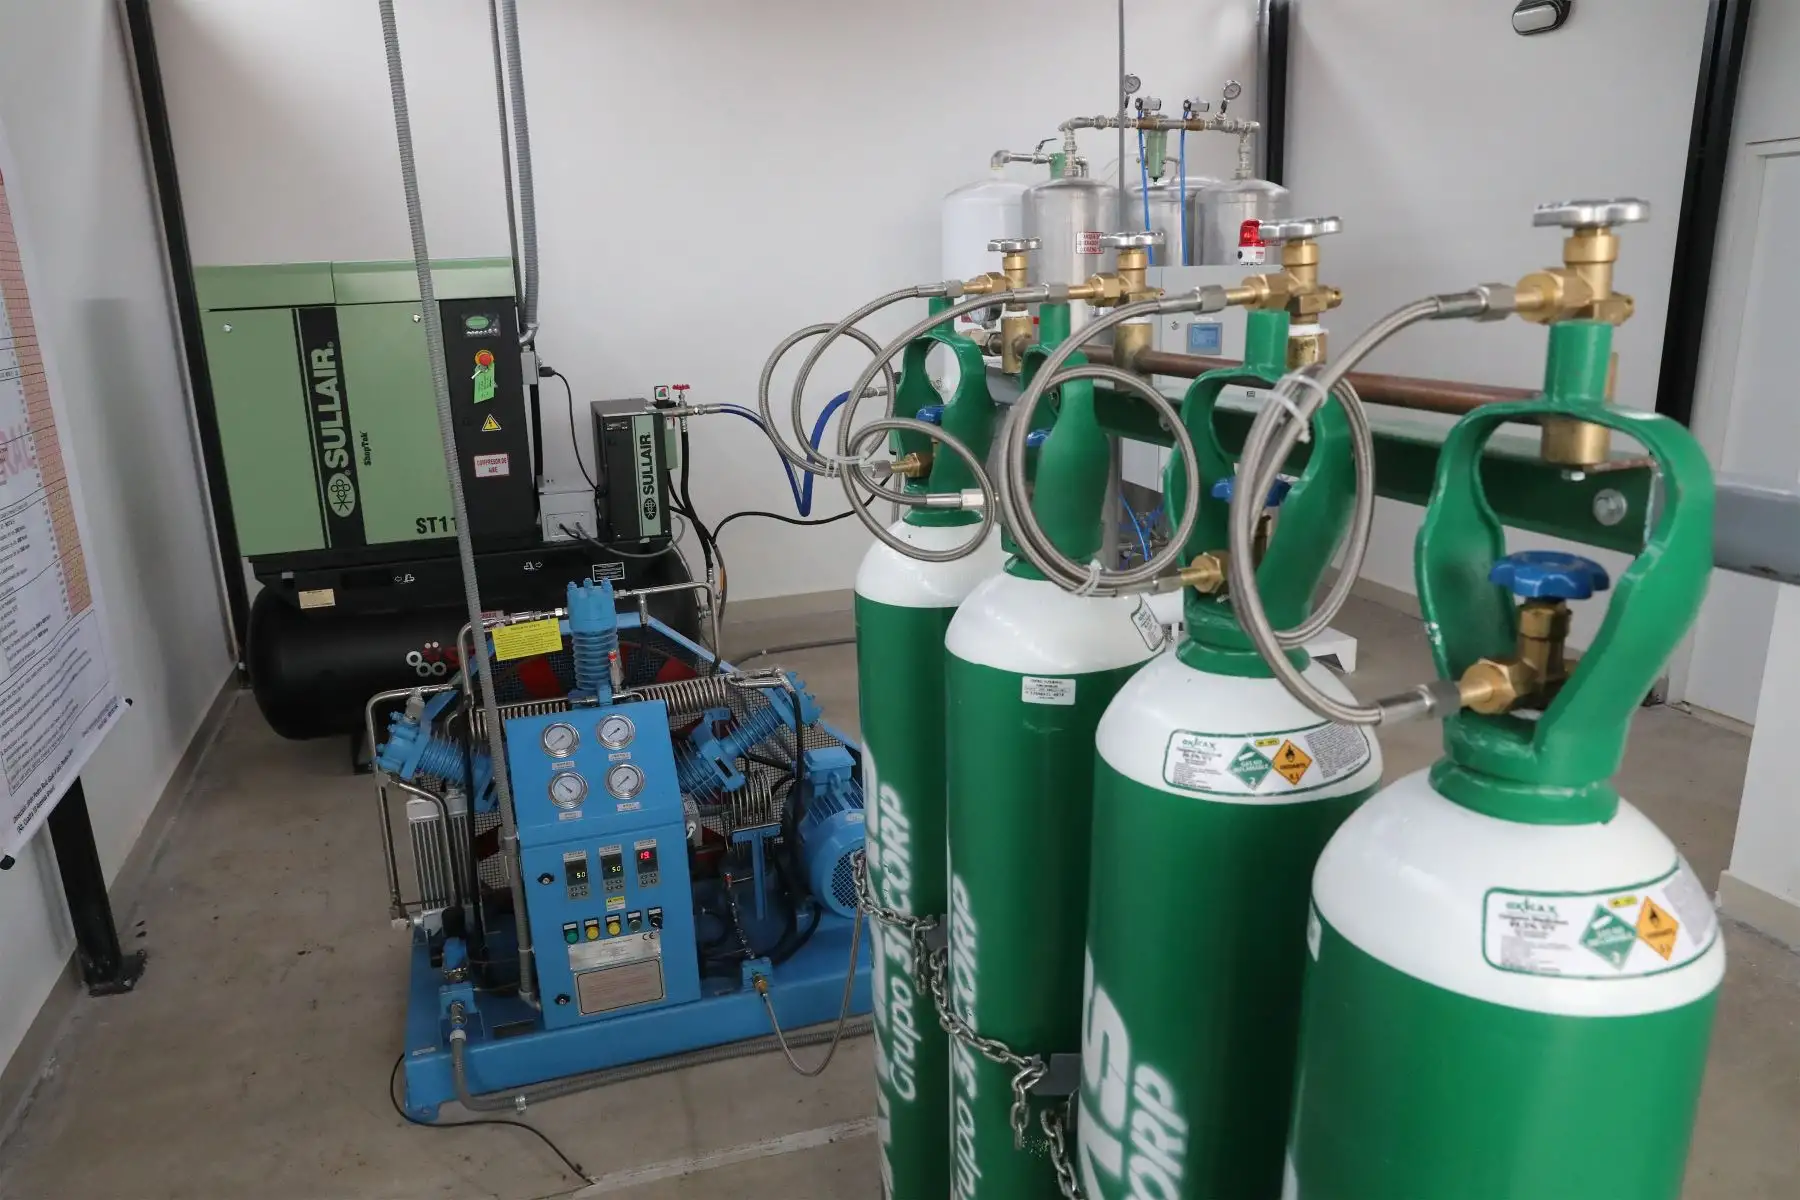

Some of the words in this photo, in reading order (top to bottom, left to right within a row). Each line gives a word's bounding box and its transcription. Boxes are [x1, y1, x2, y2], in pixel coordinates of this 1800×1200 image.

[311, 348, 349, 469] SULLAIR
[639, 434, 655, 496] SULLAIR
[888, 976, 922, 1102] Grupo
[951, 1094, 982, 1200] rupo
